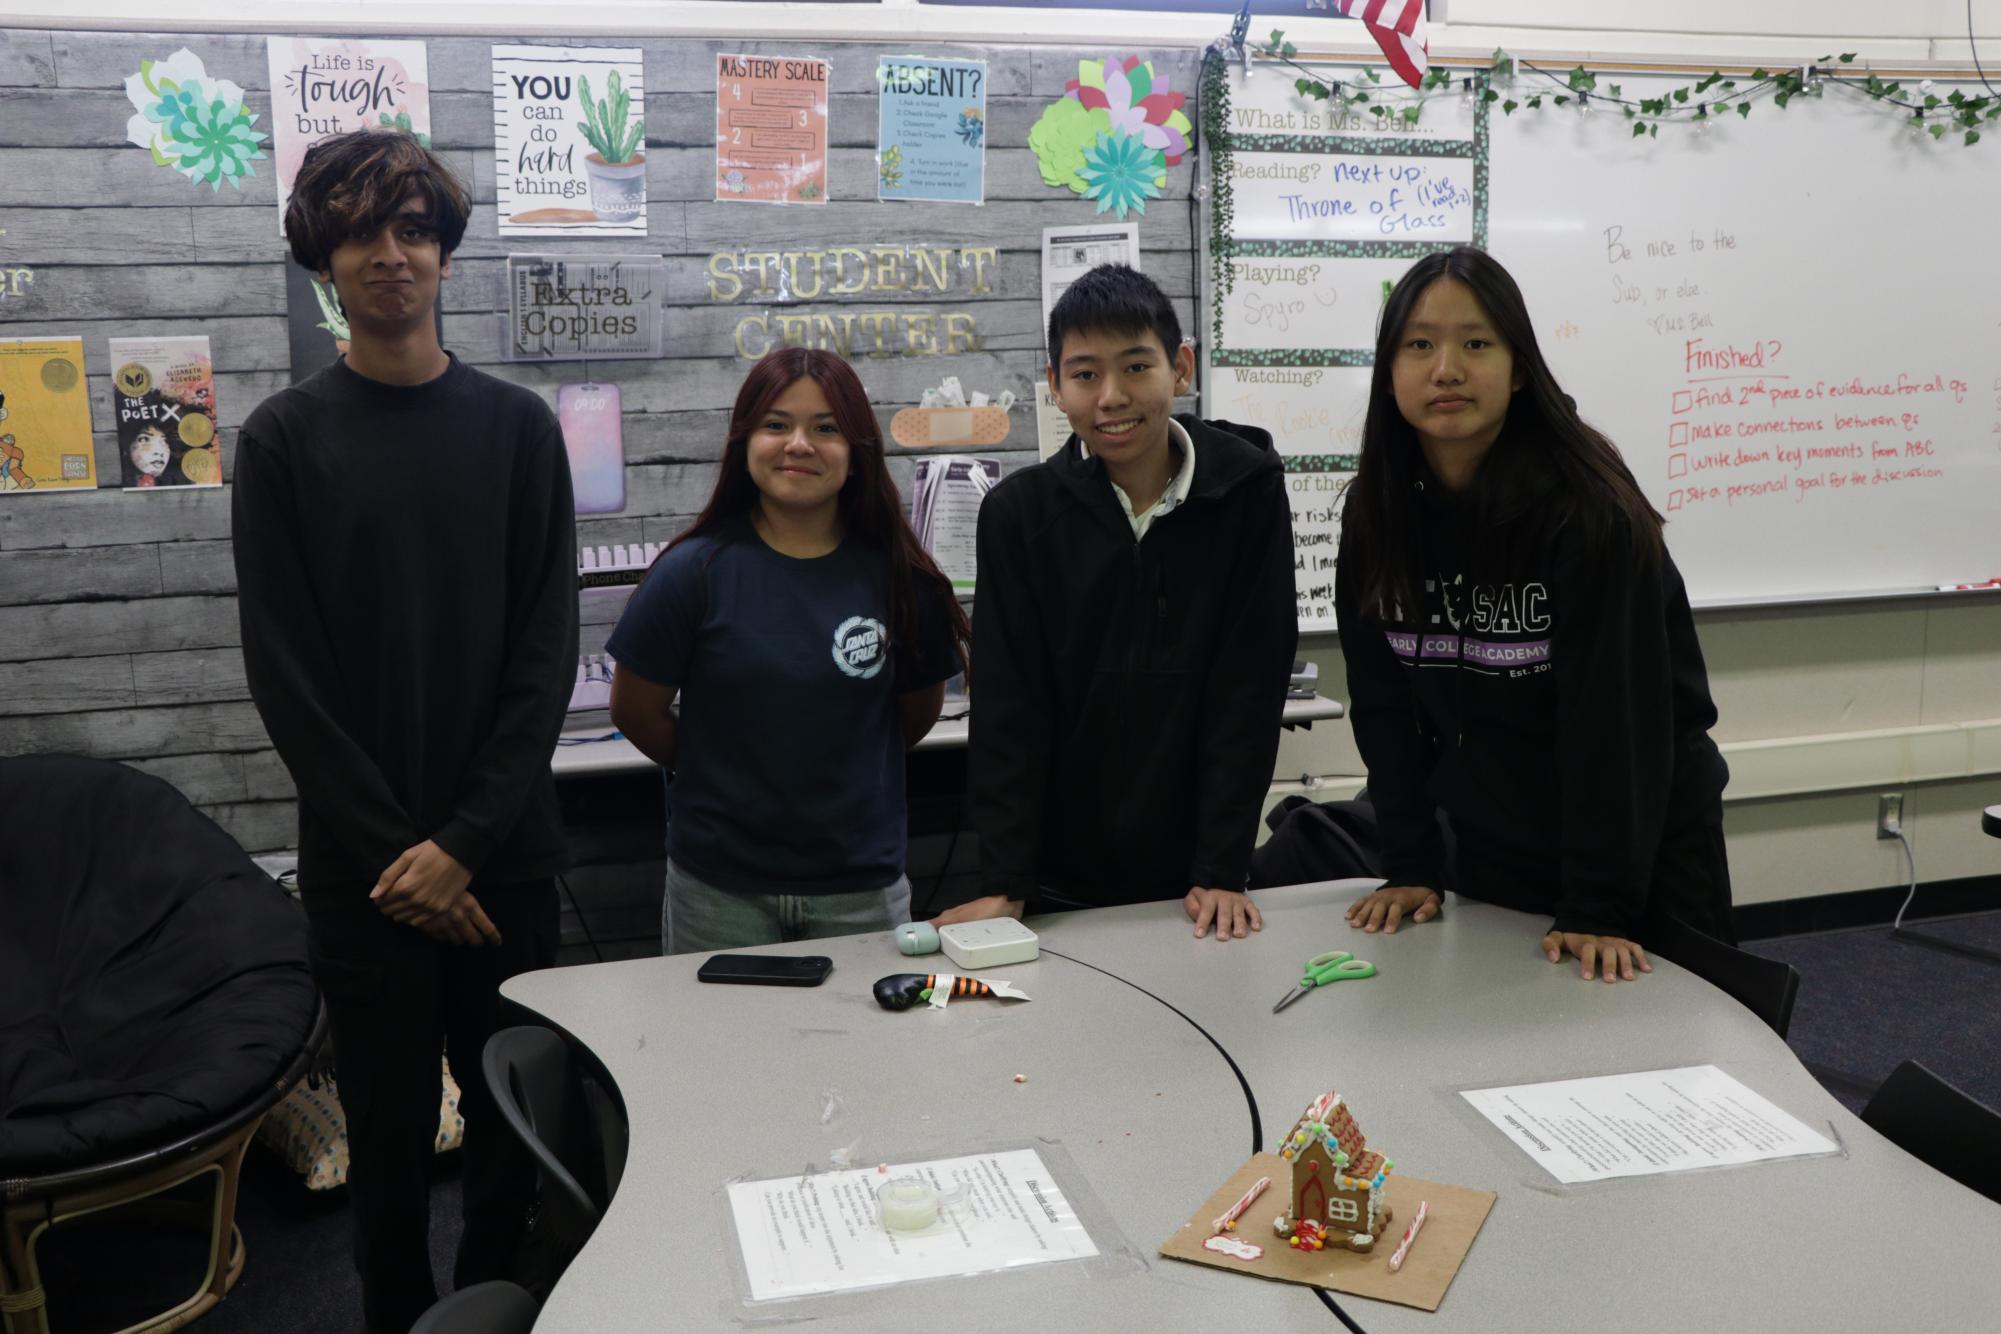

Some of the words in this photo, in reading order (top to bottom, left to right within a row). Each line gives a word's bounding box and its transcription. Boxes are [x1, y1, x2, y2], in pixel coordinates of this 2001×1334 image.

[312, 54, 350, 70] Life
[358, 56, 375, 71] is
[720, 58, 780, 79] MASTERY
[785, 62, 825, 81] SCALE
[291, 64, 395, 116] tough
[511, 75, 571, 100] YOU
[884, 64, 982, 98] ABSENT?
[732, 83, 741, 101] 4
[523, 105, 564, 120] can
[799, 110, 808, 127] 3
[1235, 109, 1296, 131] What
[1302, 110, 1320, 130] is
[1328, 110, 1367, 131] Ms.
[295, 113, 342, 134] but
[530, 124, 557, 142] do
[732, 127, 741, 144] 2
[518, 141, 574, 174] hard
[1233, 163, 1321, 182] Reading?
[515, 177, 587, 198] things
[1279, 195, 1357, 222] Throne
[1370, 189, 1404, 214] of
[1380, 214, 1446, 234] Glass
[1603, 225, 1632, 264] Be
[1647, 241, 1677, 258] nice
[1688, 229, 1704, 253] to
[1713, 229, 1736, 251] the
[708, 248, 996, 300] STUDENT
[1231, 264, 1321, 285] Playing?
[530, 281, 632, 306] Extra
[1243, 292, 1305, 332] Spyro
[526, 311, 637, 341] Copies
[735, 312, 984, 360] CENTER
[1686, 338, 1782, 373] Finished?
[1234, 368, 1323, 387] Watching?
[1695, 387, 1733, 408] find
[1769, 388, 1802, 408] piece
[1805, 381, 1825, 400] of
[1897, 373, 1921, 395] for
[1923, 374, 1944, 392] all
[124, 397, 144, 408] THE
[160, 403, 181, 422] X
[1835, 412, 1897, 430] between
[1734, 448, 1769, 466] down
[1776, 444, 1803, 471] key
[1807, 442, 1864, 460] moments
[1872, 440, 1898, 460] from
[1905, 439, 1935, 457] ABC
[1292, 475, 1312, 492] of
[1315, 475, 1345, 492] the
[1727, 474, 1789, 507] personal
[1795, 473, 1825, 503] goal
[1829, 471, 1848, 488] for
[1850, 471, 1867, 486] the
[1871, 465, 1944, 485] discussion
[1306, 507, 1341, 523] risks
[1294, 531, 1333, 548] become
[583, 573, 621, 585] Phone
[1472, 583, 1551, 633] SAC
[843, 630, 879, 652] SANTA
[848, 643, 879, 665] CRUZ
[1509, 668, 1532, 678] Est.
